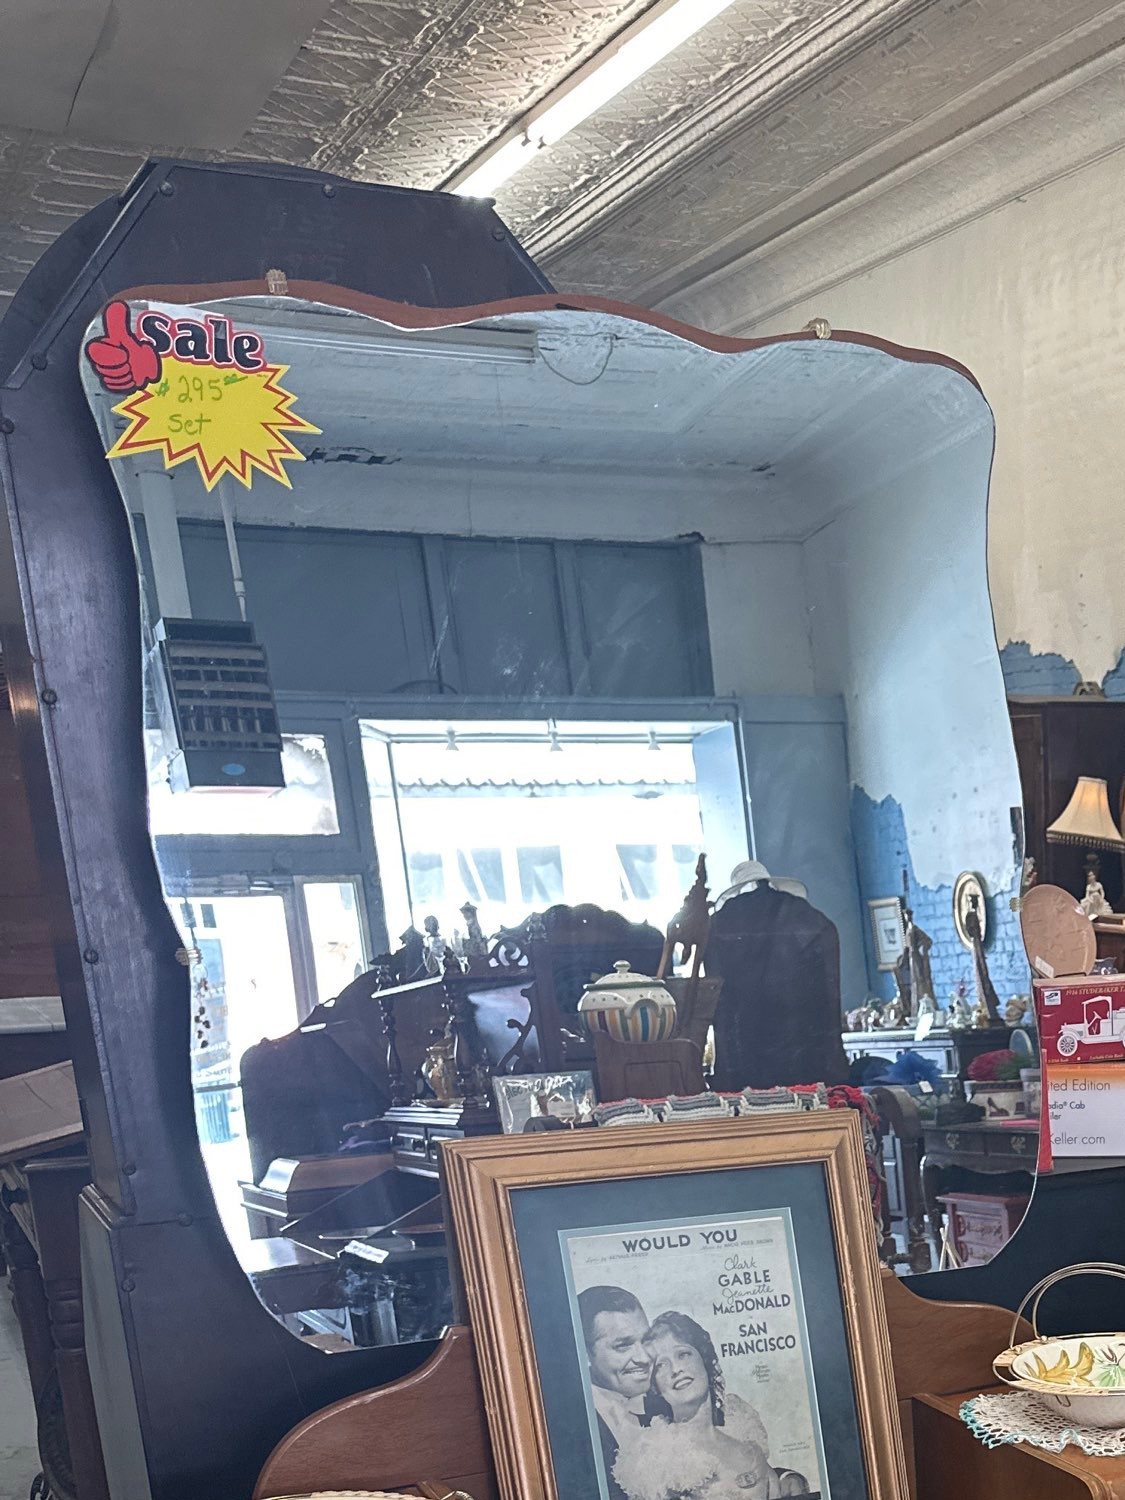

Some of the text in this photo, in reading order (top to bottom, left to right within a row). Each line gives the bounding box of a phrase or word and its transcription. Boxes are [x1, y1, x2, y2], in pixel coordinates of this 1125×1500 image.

[167, 412, 212, 436] Set
[1079, 985, 1120, 996] STUDEBAKER
[1047, 1078, 1111, 1092] ited Edition
[1069, 1100, 1086, 1110] Cab
[622, 1229, 738, 1253] WOULD YOU
[724, 1254, 758, 1272] Clark
[718, 1269, 771, 1287] GABLE
[721, 1284, 774, 1305] Jeanette
[739, 1322, 768, 1337] SAN
[721, 1335, 796, 1358] FRANCISCO
